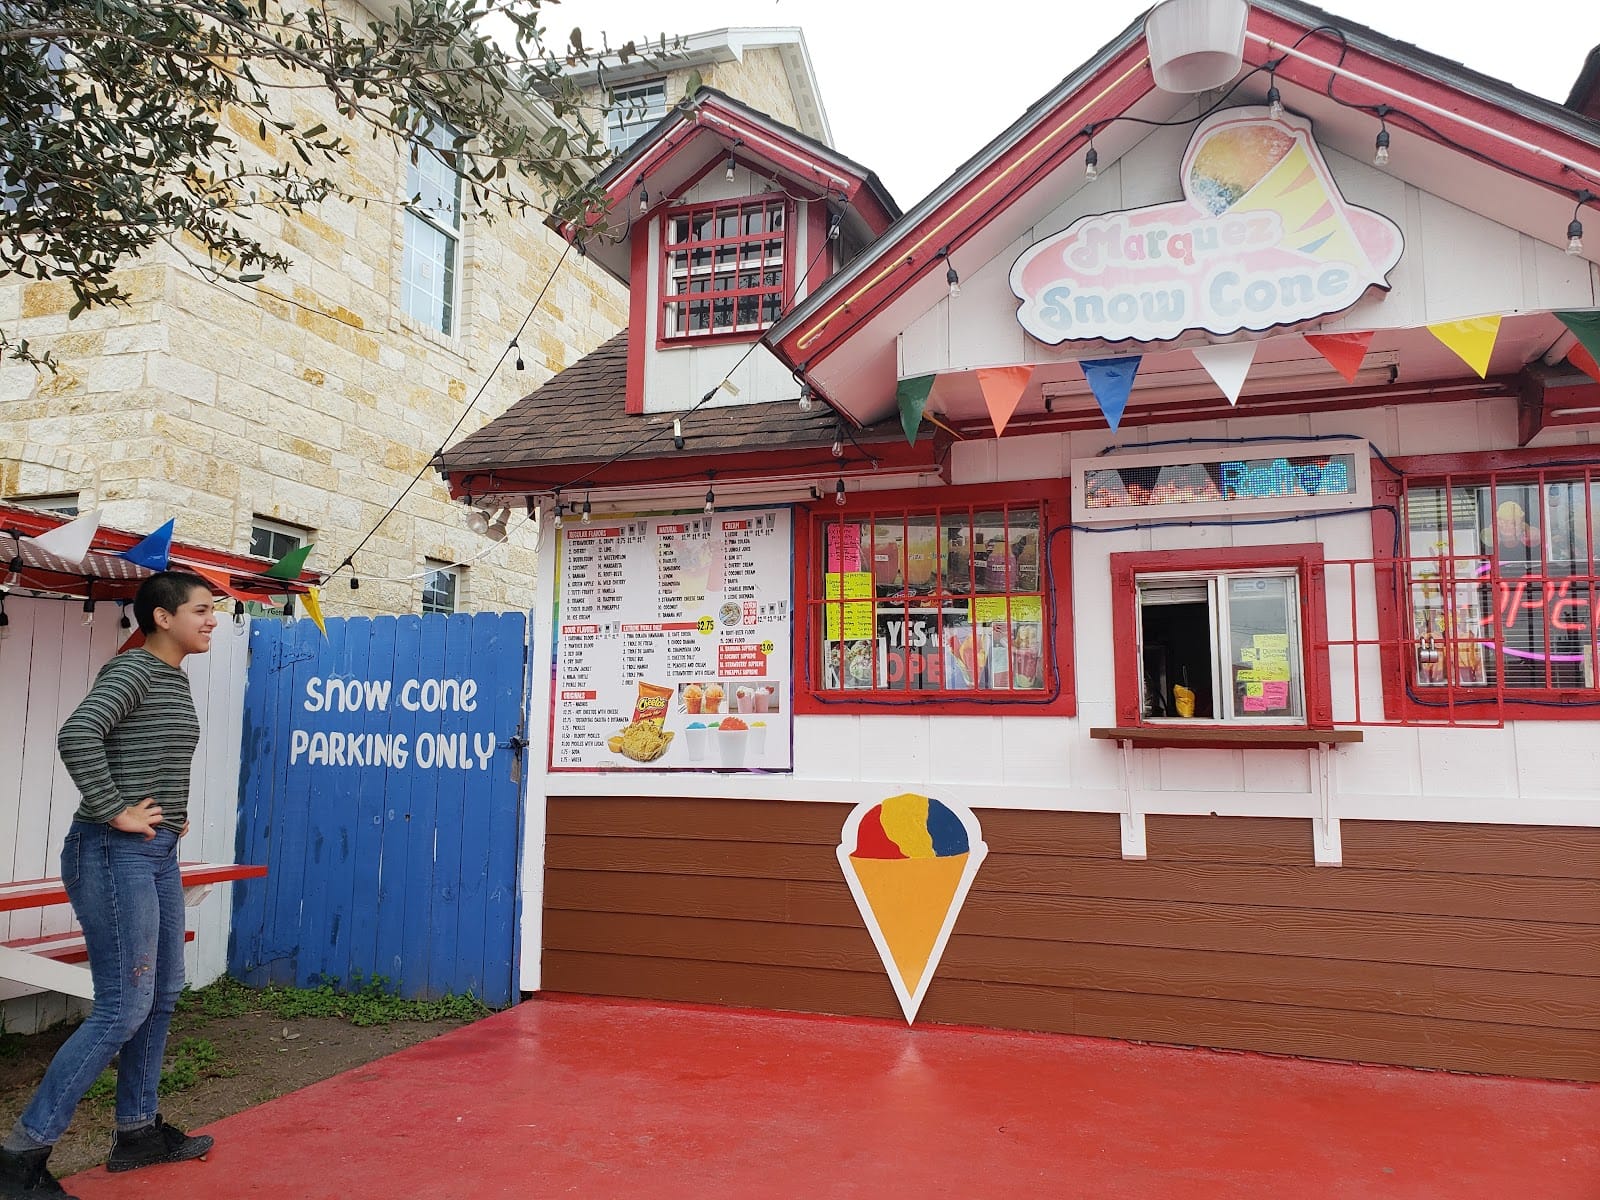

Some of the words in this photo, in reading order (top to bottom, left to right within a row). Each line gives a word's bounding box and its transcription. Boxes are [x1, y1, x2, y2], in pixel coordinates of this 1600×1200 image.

[1070, 215, 1275, 267] Marquez
[1039, 284, 1186, 330] Snow
[1209, 268, 1350, 317] Cone
[1477, 573, 1600, 630] OPE
[697, 621, 714, 630] $2.75
[887, 620, 927, 647] YES
[639, 696, 665, 710] Cheetos
[290, 730, 409, 769] PARKING
[415, 732, 496, 771] ONLY
